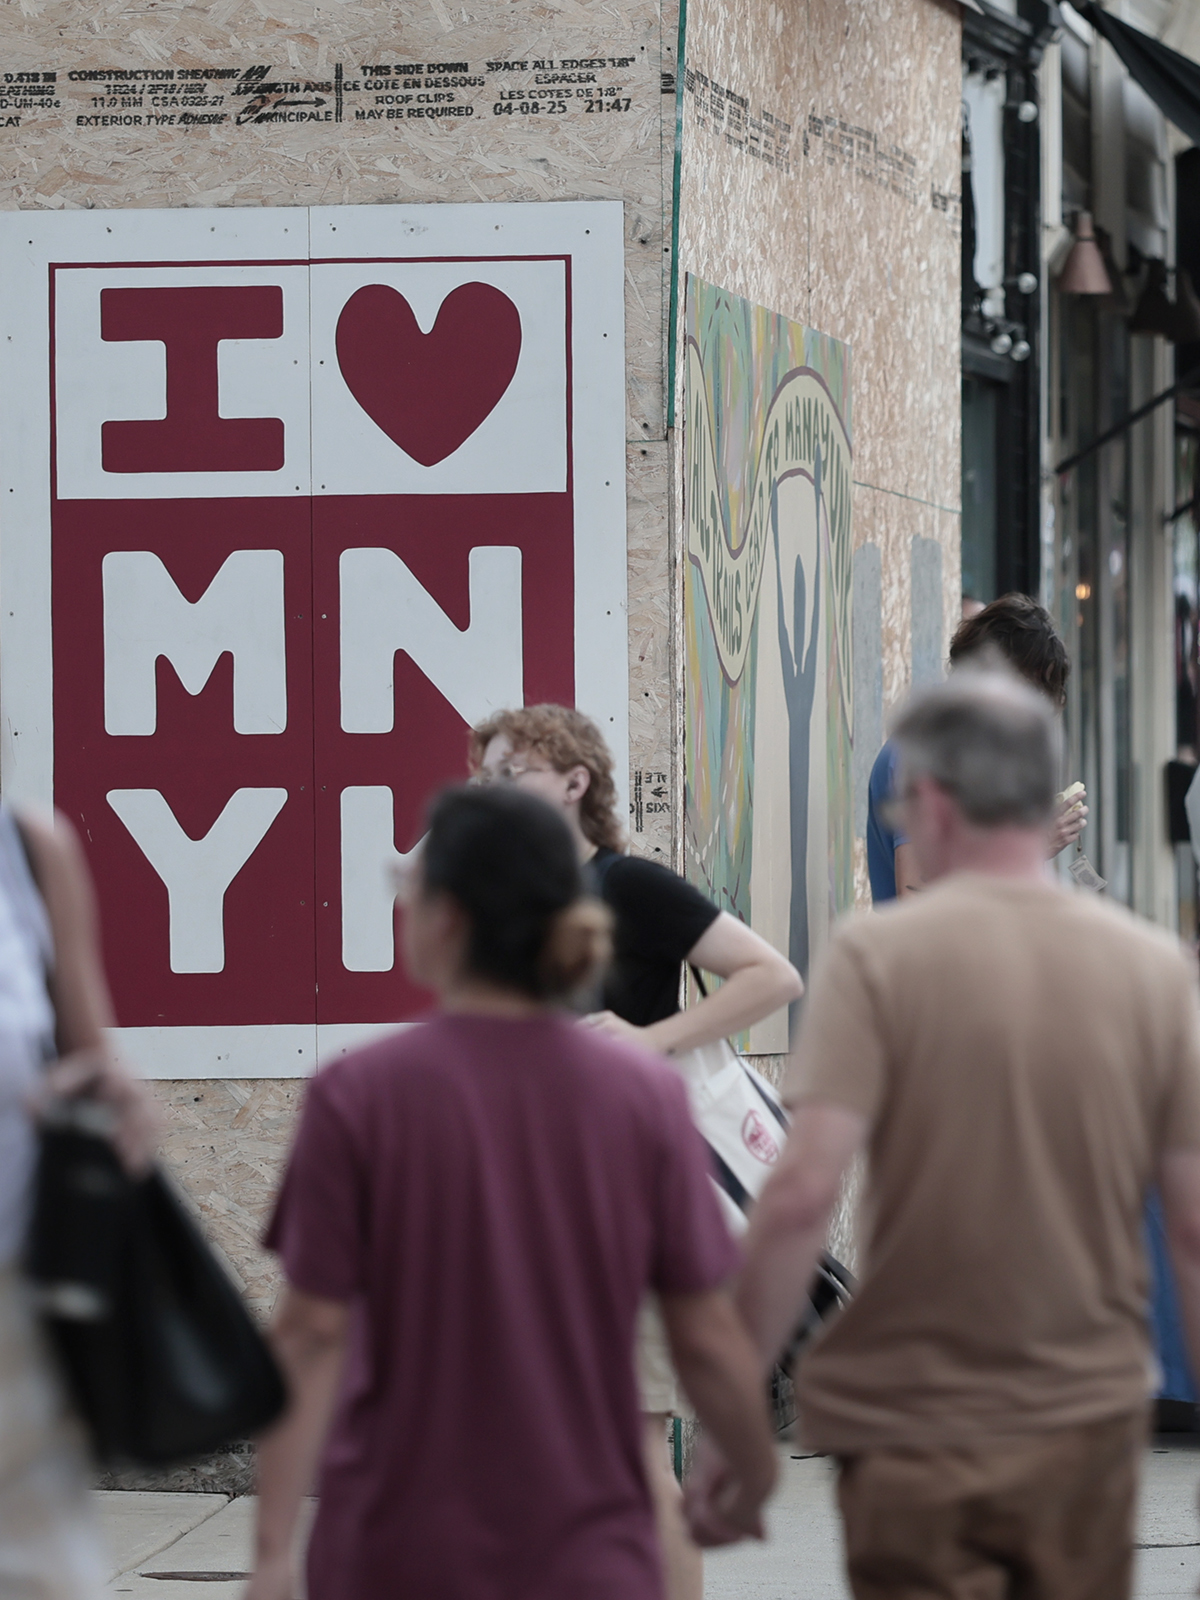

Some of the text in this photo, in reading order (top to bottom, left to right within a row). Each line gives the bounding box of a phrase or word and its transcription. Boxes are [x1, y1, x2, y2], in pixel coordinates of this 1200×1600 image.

[361, 62, 469, 76] THIS SIDE DOWN
[486, 61, 528, 72] SPACE
[532, 60, 558, 70] ALL
[561, 58, 606, 69] EDGES
[68, 69, 174, 81] CONSTRUCTION
[535, 72, 597, 84] ESPACER
[343, 80, 361, 91] CE
[403, 78, 422, 89] EN
[424, 76, 486, 88] DESSOUS
[375, 93, 456, 105] ROOF CLIPS
[500, 88, 525, 100] LES
[528, 87, 573, 99] COTES
[576, 88, 594, 98] DE
[355, 106, 475, 121] MAY BE REQUIRED
[493, 97, 632, 116] 04-08-25 21:47
[76, 115, 143, 127] EXTERIOR
[146, 114, 176, 126] TYPE
[100, 284, 285, 474] I
[765, 418, 780, 500] TO
